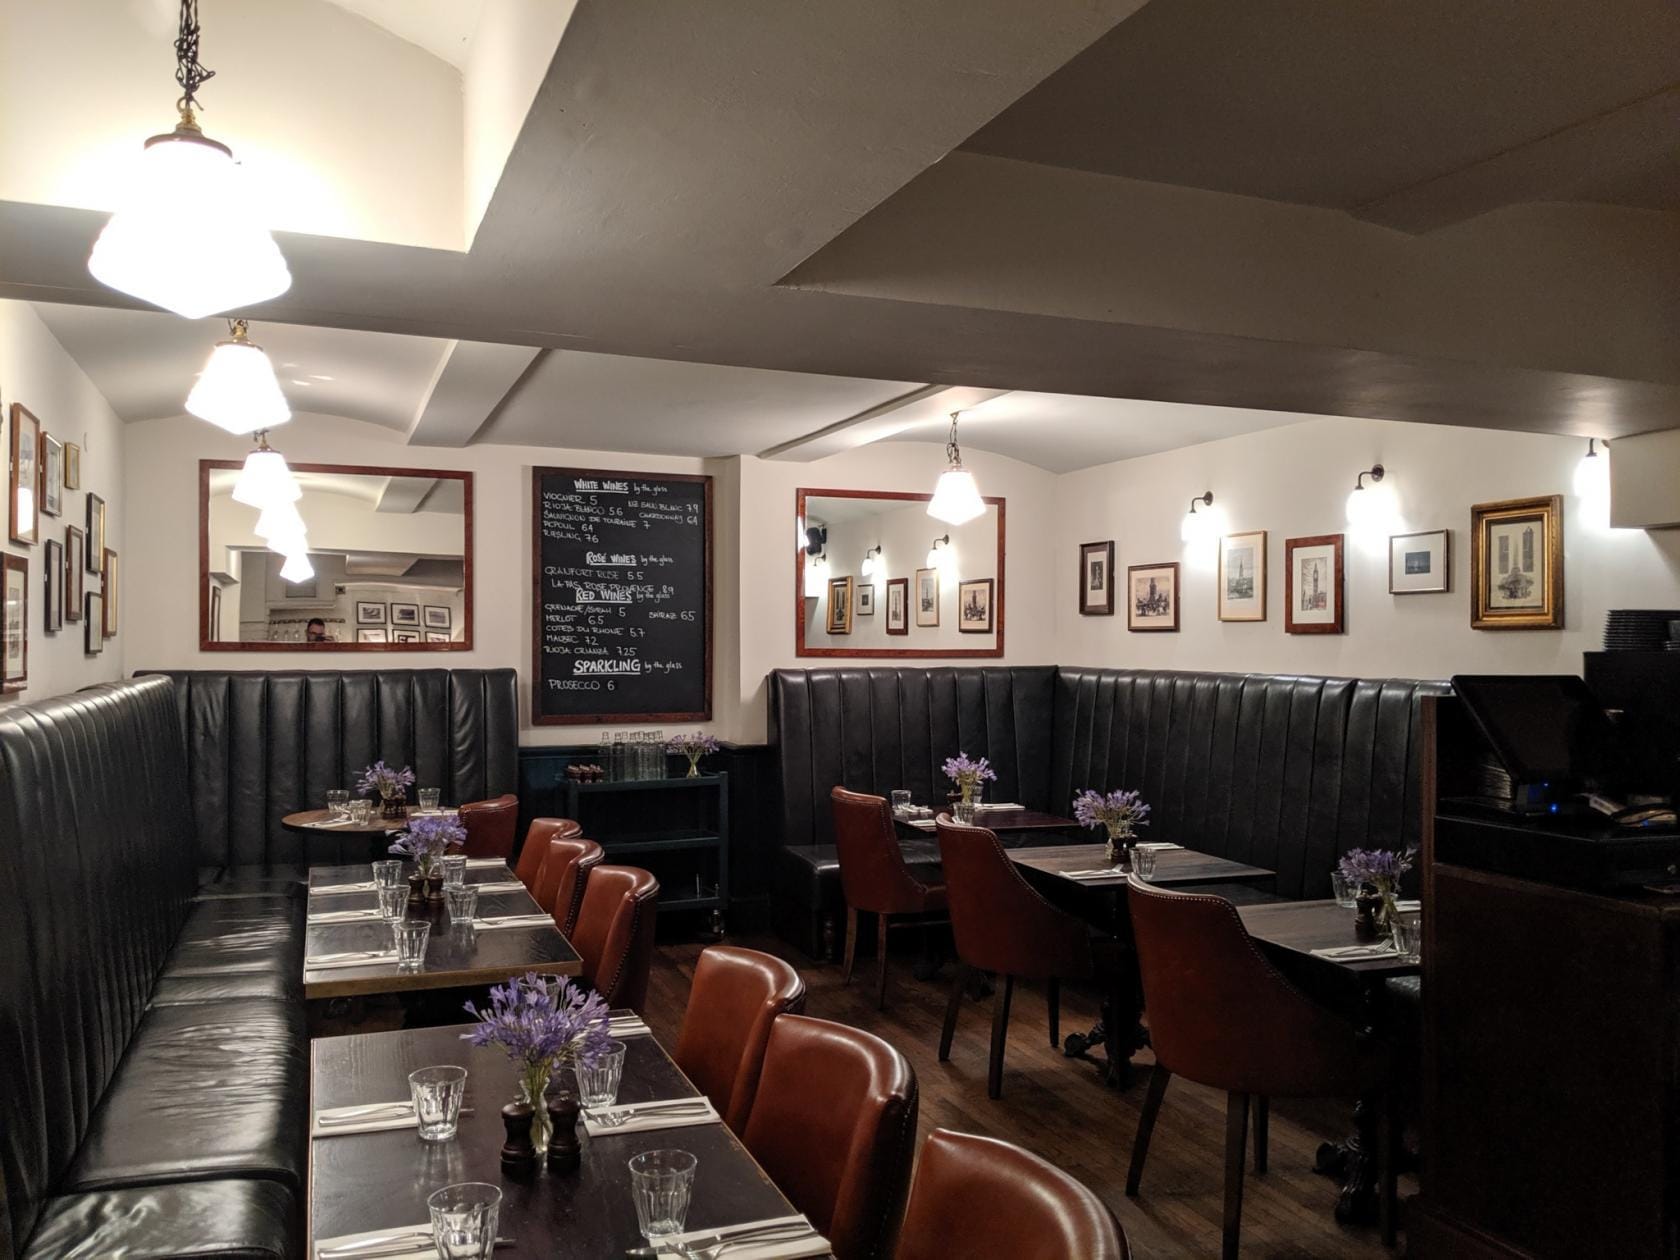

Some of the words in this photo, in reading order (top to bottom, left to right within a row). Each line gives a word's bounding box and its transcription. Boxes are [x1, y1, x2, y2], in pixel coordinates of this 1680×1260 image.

[574, 479, 599, 490] WHITE
[603, 481, 629, 492] WINES
[611, 553, 637, 565] WINES
[576, 588, 594, 600] RED
[601, 591, 632, 602] WINES
[573, 659, 641, 674] SPARKLING
